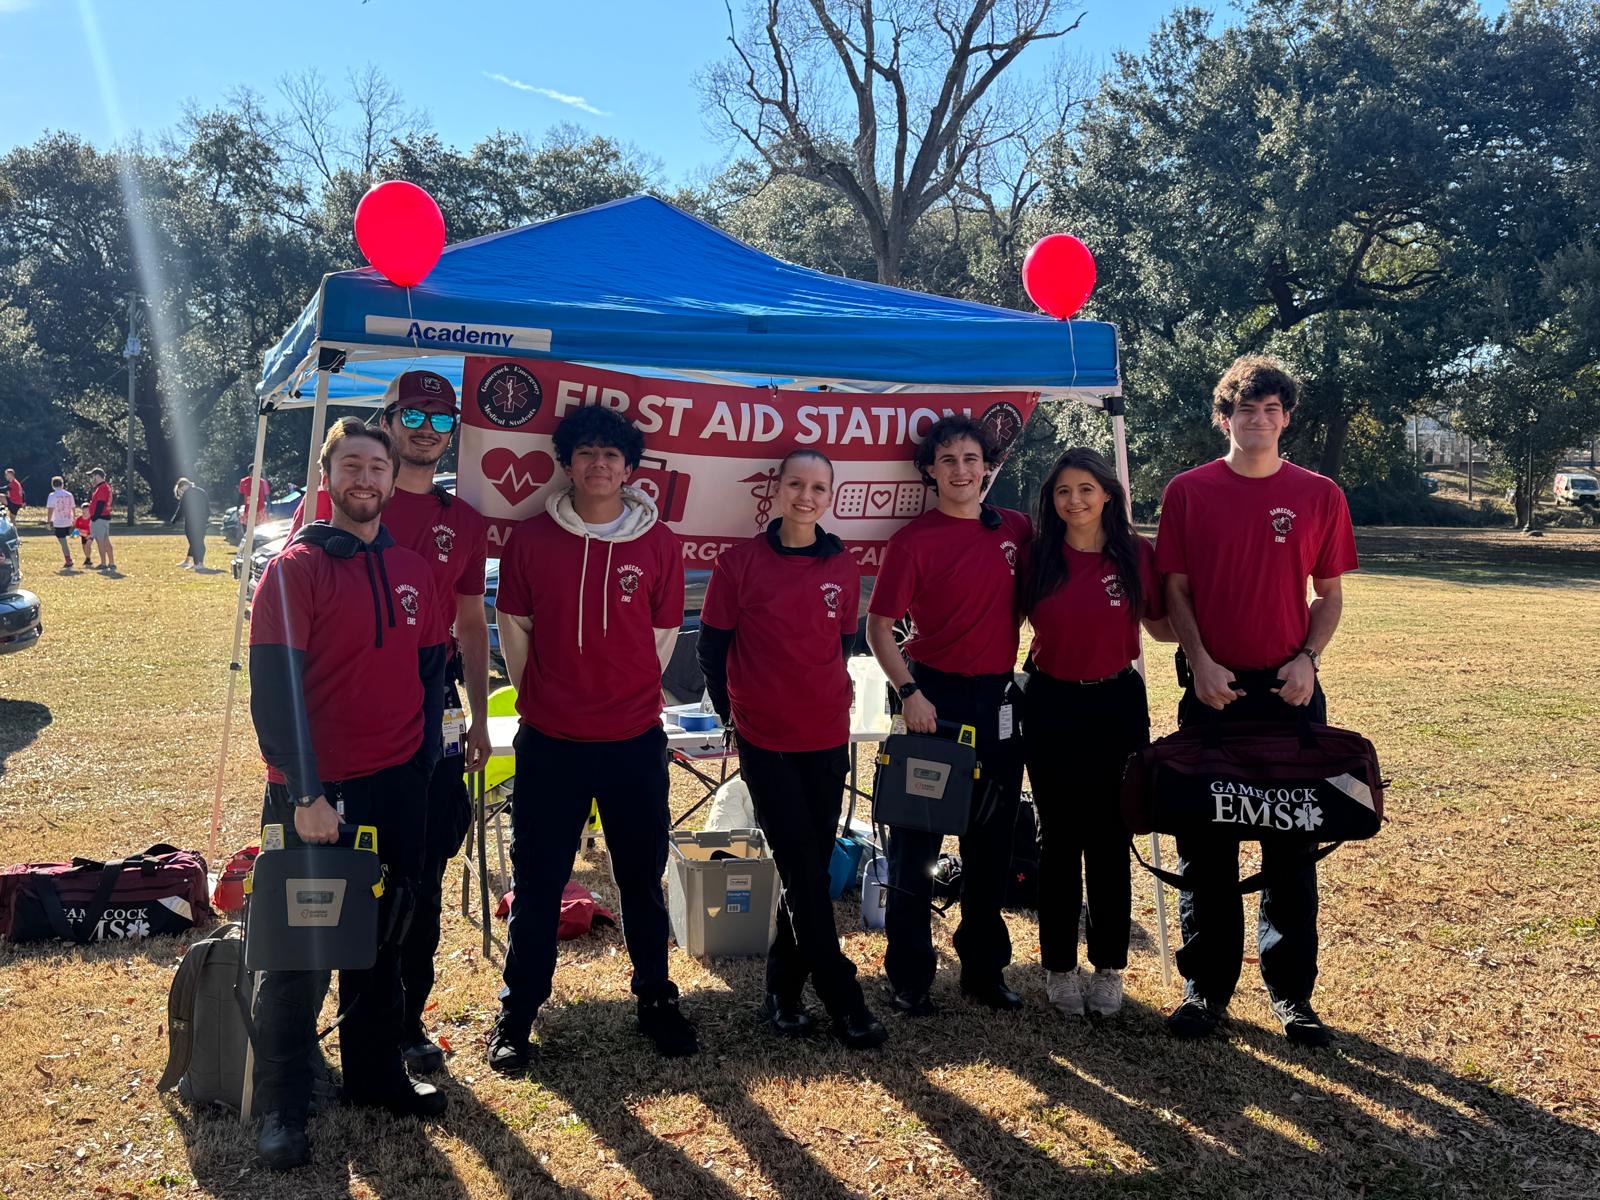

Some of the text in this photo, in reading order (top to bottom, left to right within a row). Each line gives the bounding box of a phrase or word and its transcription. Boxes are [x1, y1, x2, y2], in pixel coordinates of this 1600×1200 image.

[406, 322, 514, 348] Academy
[699, 401, 784, 442] AID
[1269, 507, 1297, 519] GAMECOCK
[1274, 535, 1286, 543] EMS
[1110, 599, 1121, 607] EMS
[1210, 780, 1318, 803] GAMECOCK
[1211, 793, 1293, 831] EMS
